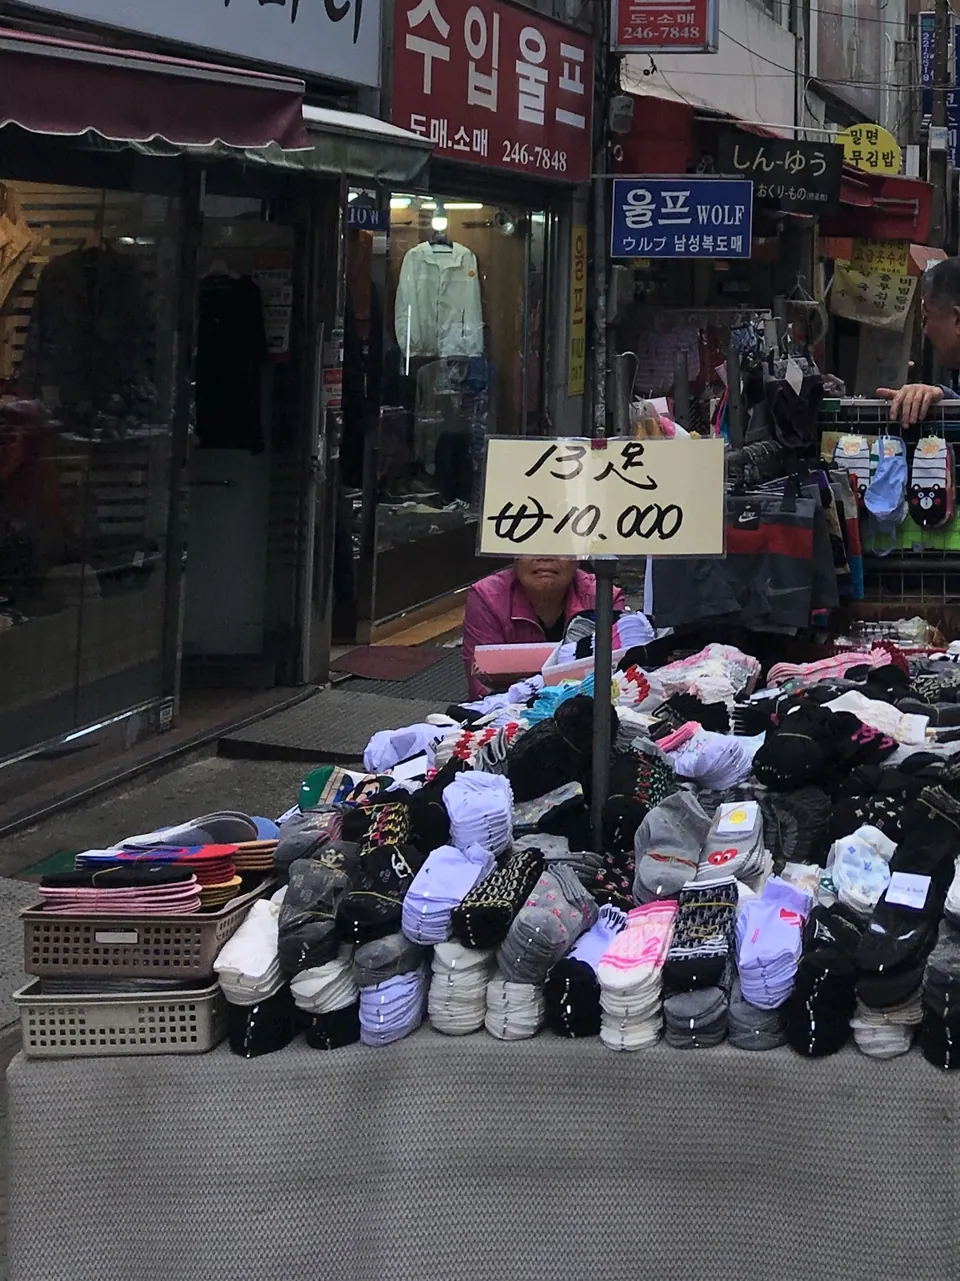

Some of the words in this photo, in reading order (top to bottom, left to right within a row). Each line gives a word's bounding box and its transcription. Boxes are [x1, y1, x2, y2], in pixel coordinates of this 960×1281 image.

[622, 26, 700, 39] 246-7848
[850, 129, 878, 145] 밀면
[501, 140, 568, 172] 246-7848
[843, 150, 895, 168] 무김밥
[622, 188, 693, 229] 울프
[696, 204, 745, 226] WOLF
[674, 235, 743, 253] 남성복도매
